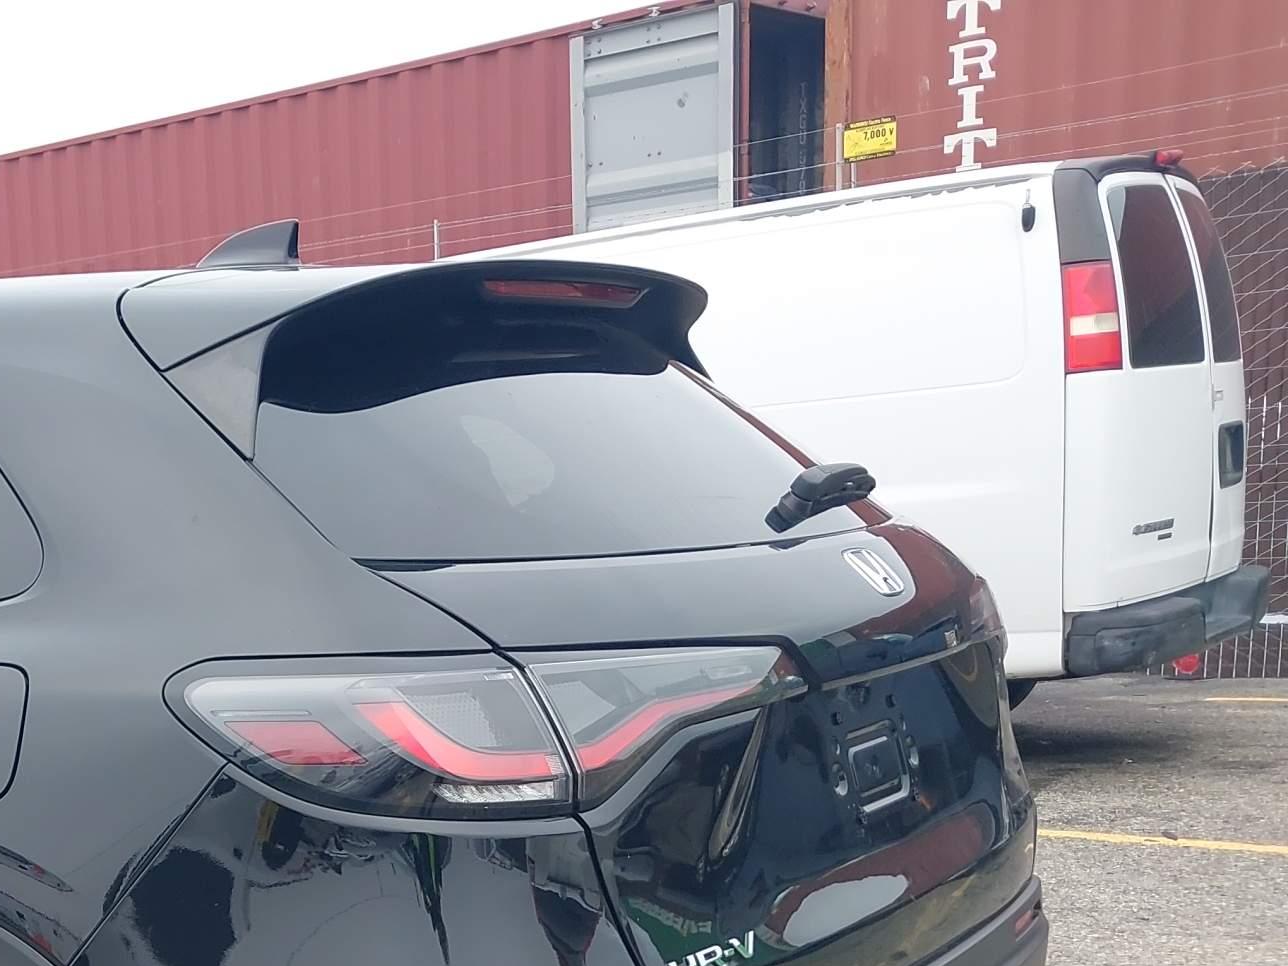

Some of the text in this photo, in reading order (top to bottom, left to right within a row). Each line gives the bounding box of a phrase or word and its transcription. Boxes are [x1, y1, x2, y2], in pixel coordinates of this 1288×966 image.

[943, 0, 1001, 173] TRIT
[863, 128, 887, 142] 7,000
[889, 127, 894, 136] V
